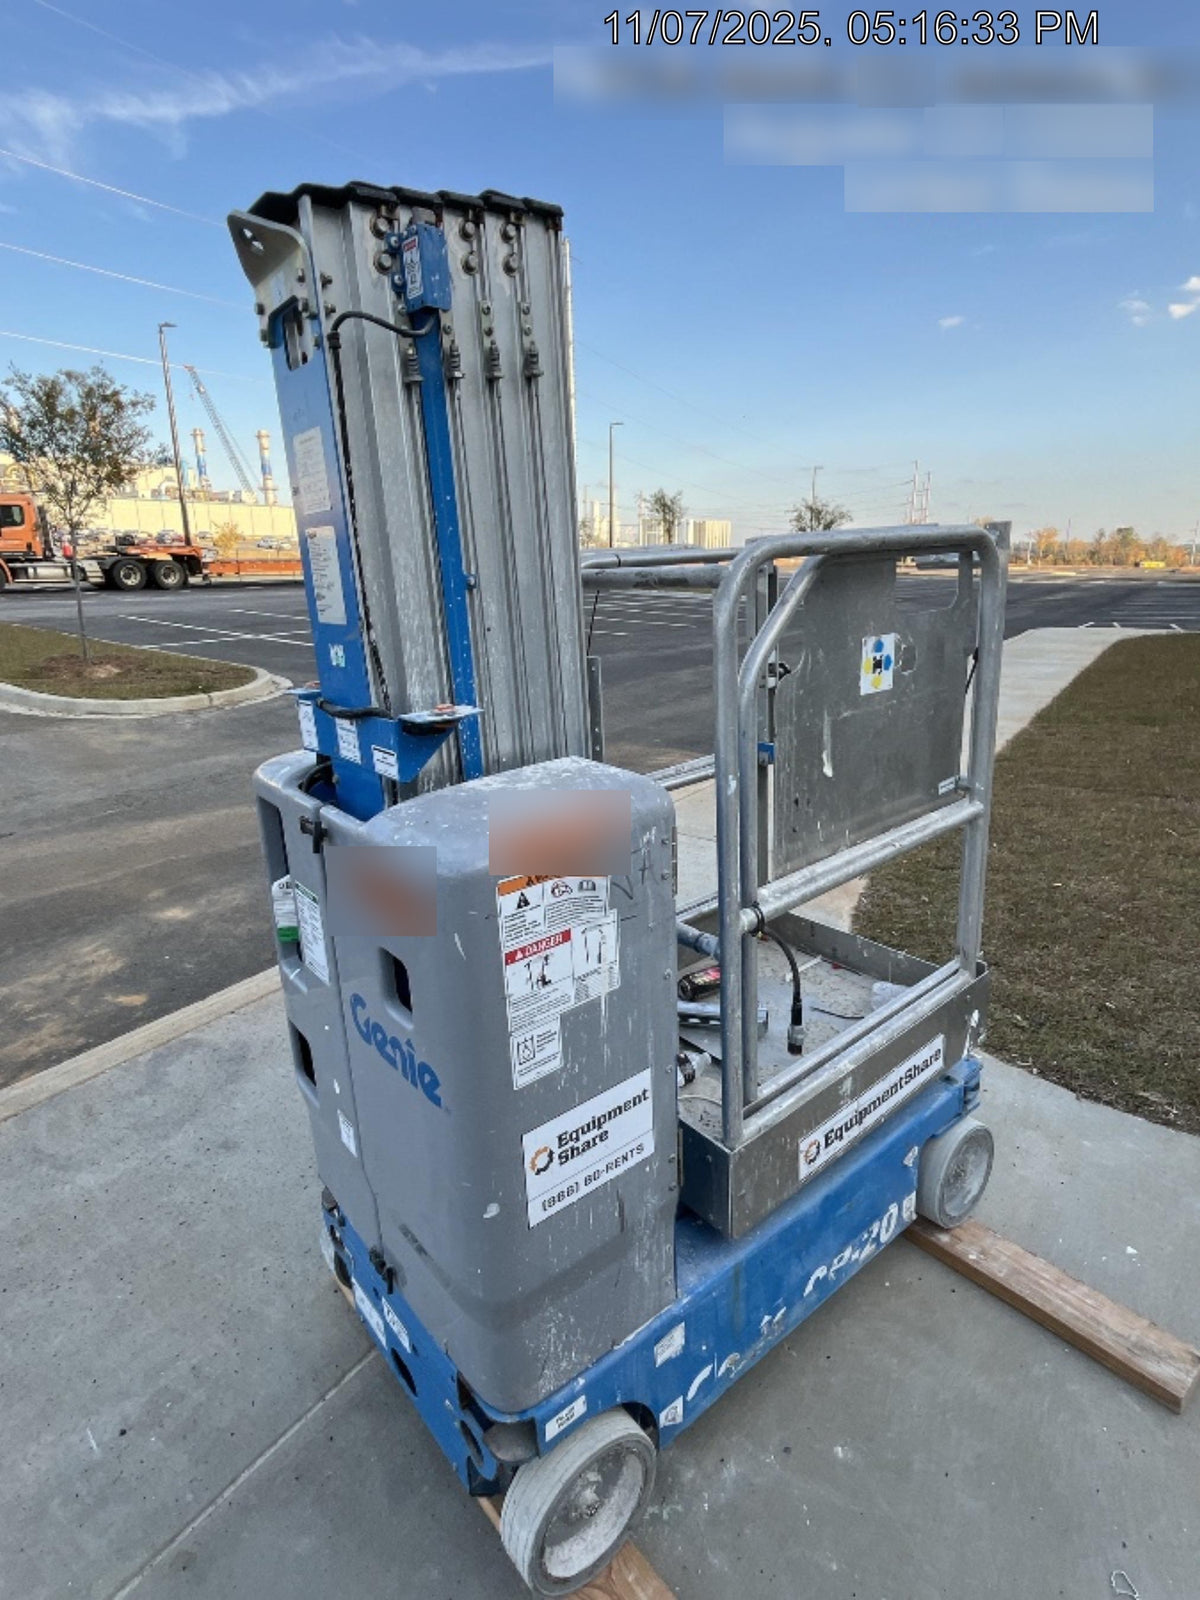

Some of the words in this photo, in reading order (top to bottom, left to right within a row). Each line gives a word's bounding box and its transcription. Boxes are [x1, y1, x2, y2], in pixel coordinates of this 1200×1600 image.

[526, 935, 563, 957] DANGER
[350, 993, 442, 1108] Genie
[556, 1088, 649, 1150] Equipment
[823, 1048, 941, 1149] EquipmentShare
[557, 1130, 609, 1166] Share
